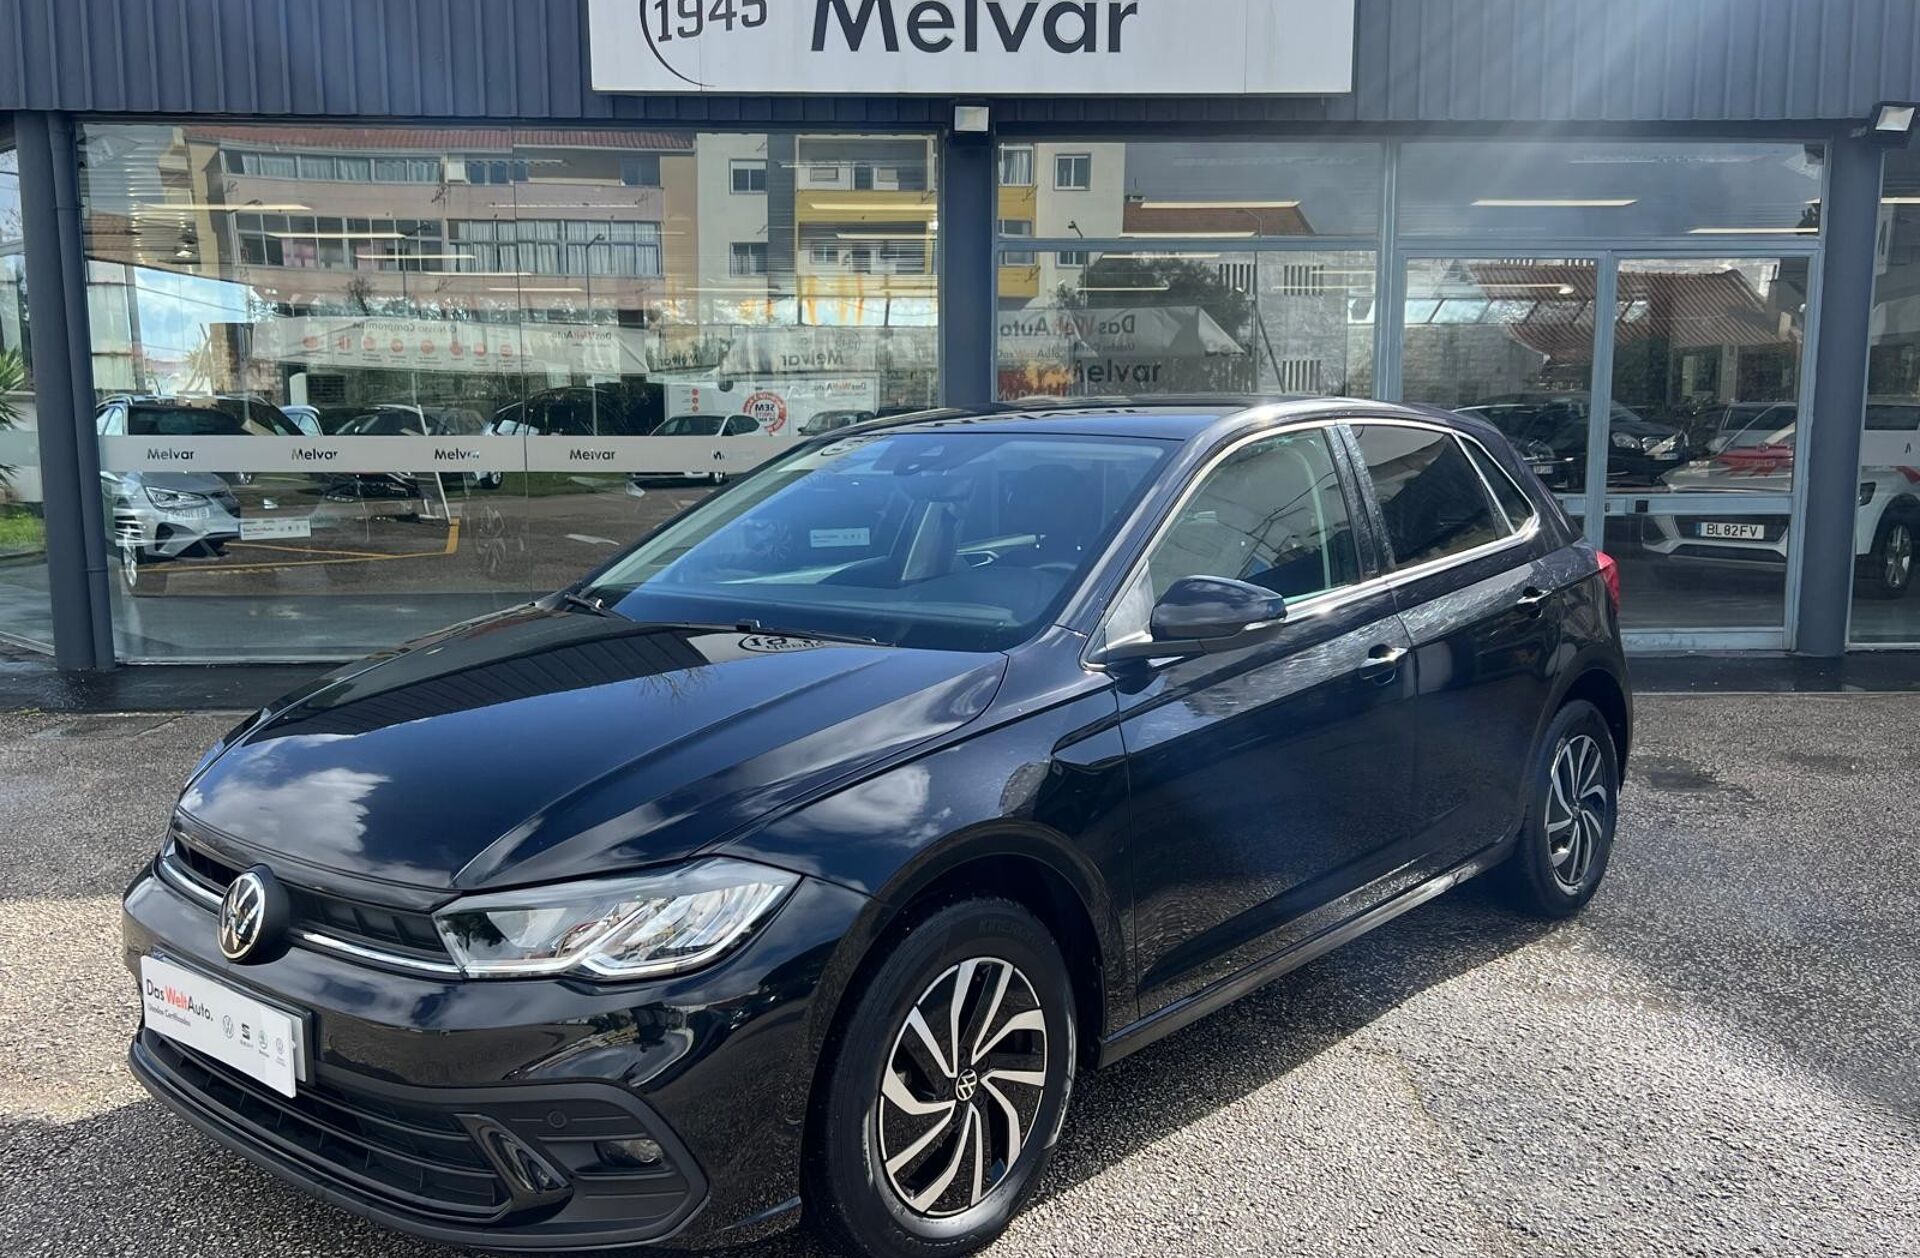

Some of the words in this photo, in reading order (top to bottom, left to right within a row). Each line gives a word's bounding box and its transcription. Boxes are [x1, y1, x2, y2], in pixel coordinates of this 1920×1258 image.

[654, 0, 768, 43] 1945
[811, 0, 1138, 54] Melvar
[146, 447, 195, 461] Melvar
[291, 447, 338, 461] Melvar
